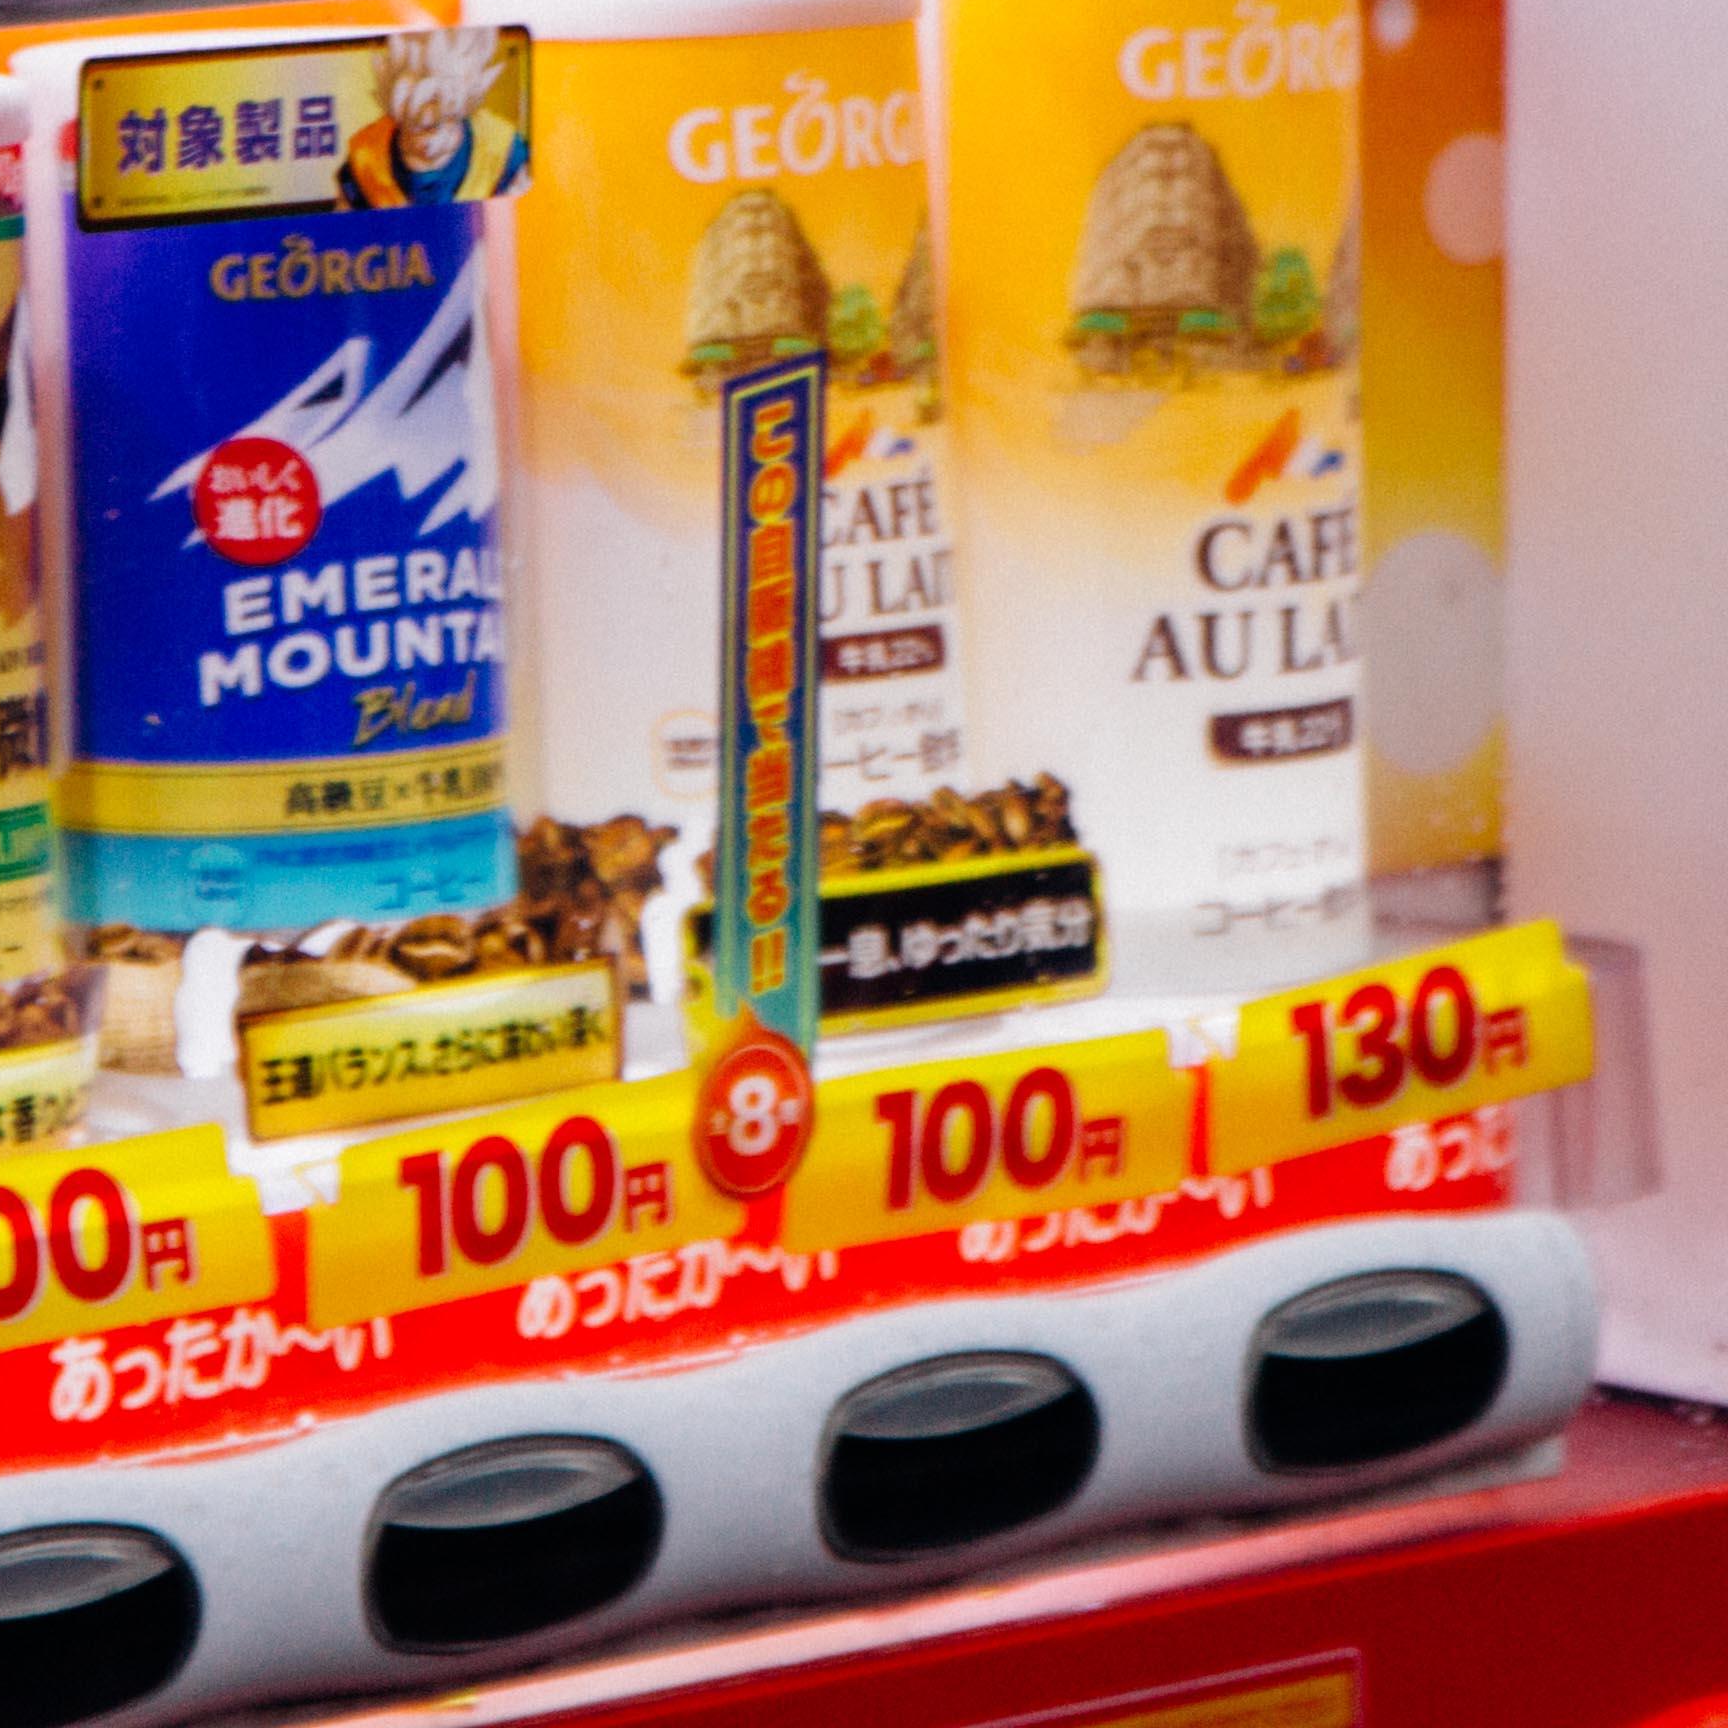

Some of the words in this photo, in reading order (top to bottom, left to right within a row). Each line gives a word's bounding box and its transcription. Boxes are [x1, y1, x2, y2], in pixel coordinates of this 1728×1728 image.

[118, 94, 338, 174] 対象製品
[209, 234, 435, 302] GEORGIA
[214, 499, 306, 542] 進化
[1130, 610, 1257, 681] AU
[352, 672, 478, 748] Blend
[1290, 965, 1529, 1120] 130円
[875, 1067, 1126, 1211] 100円
[399, 1114, 675, 1277] 100円
